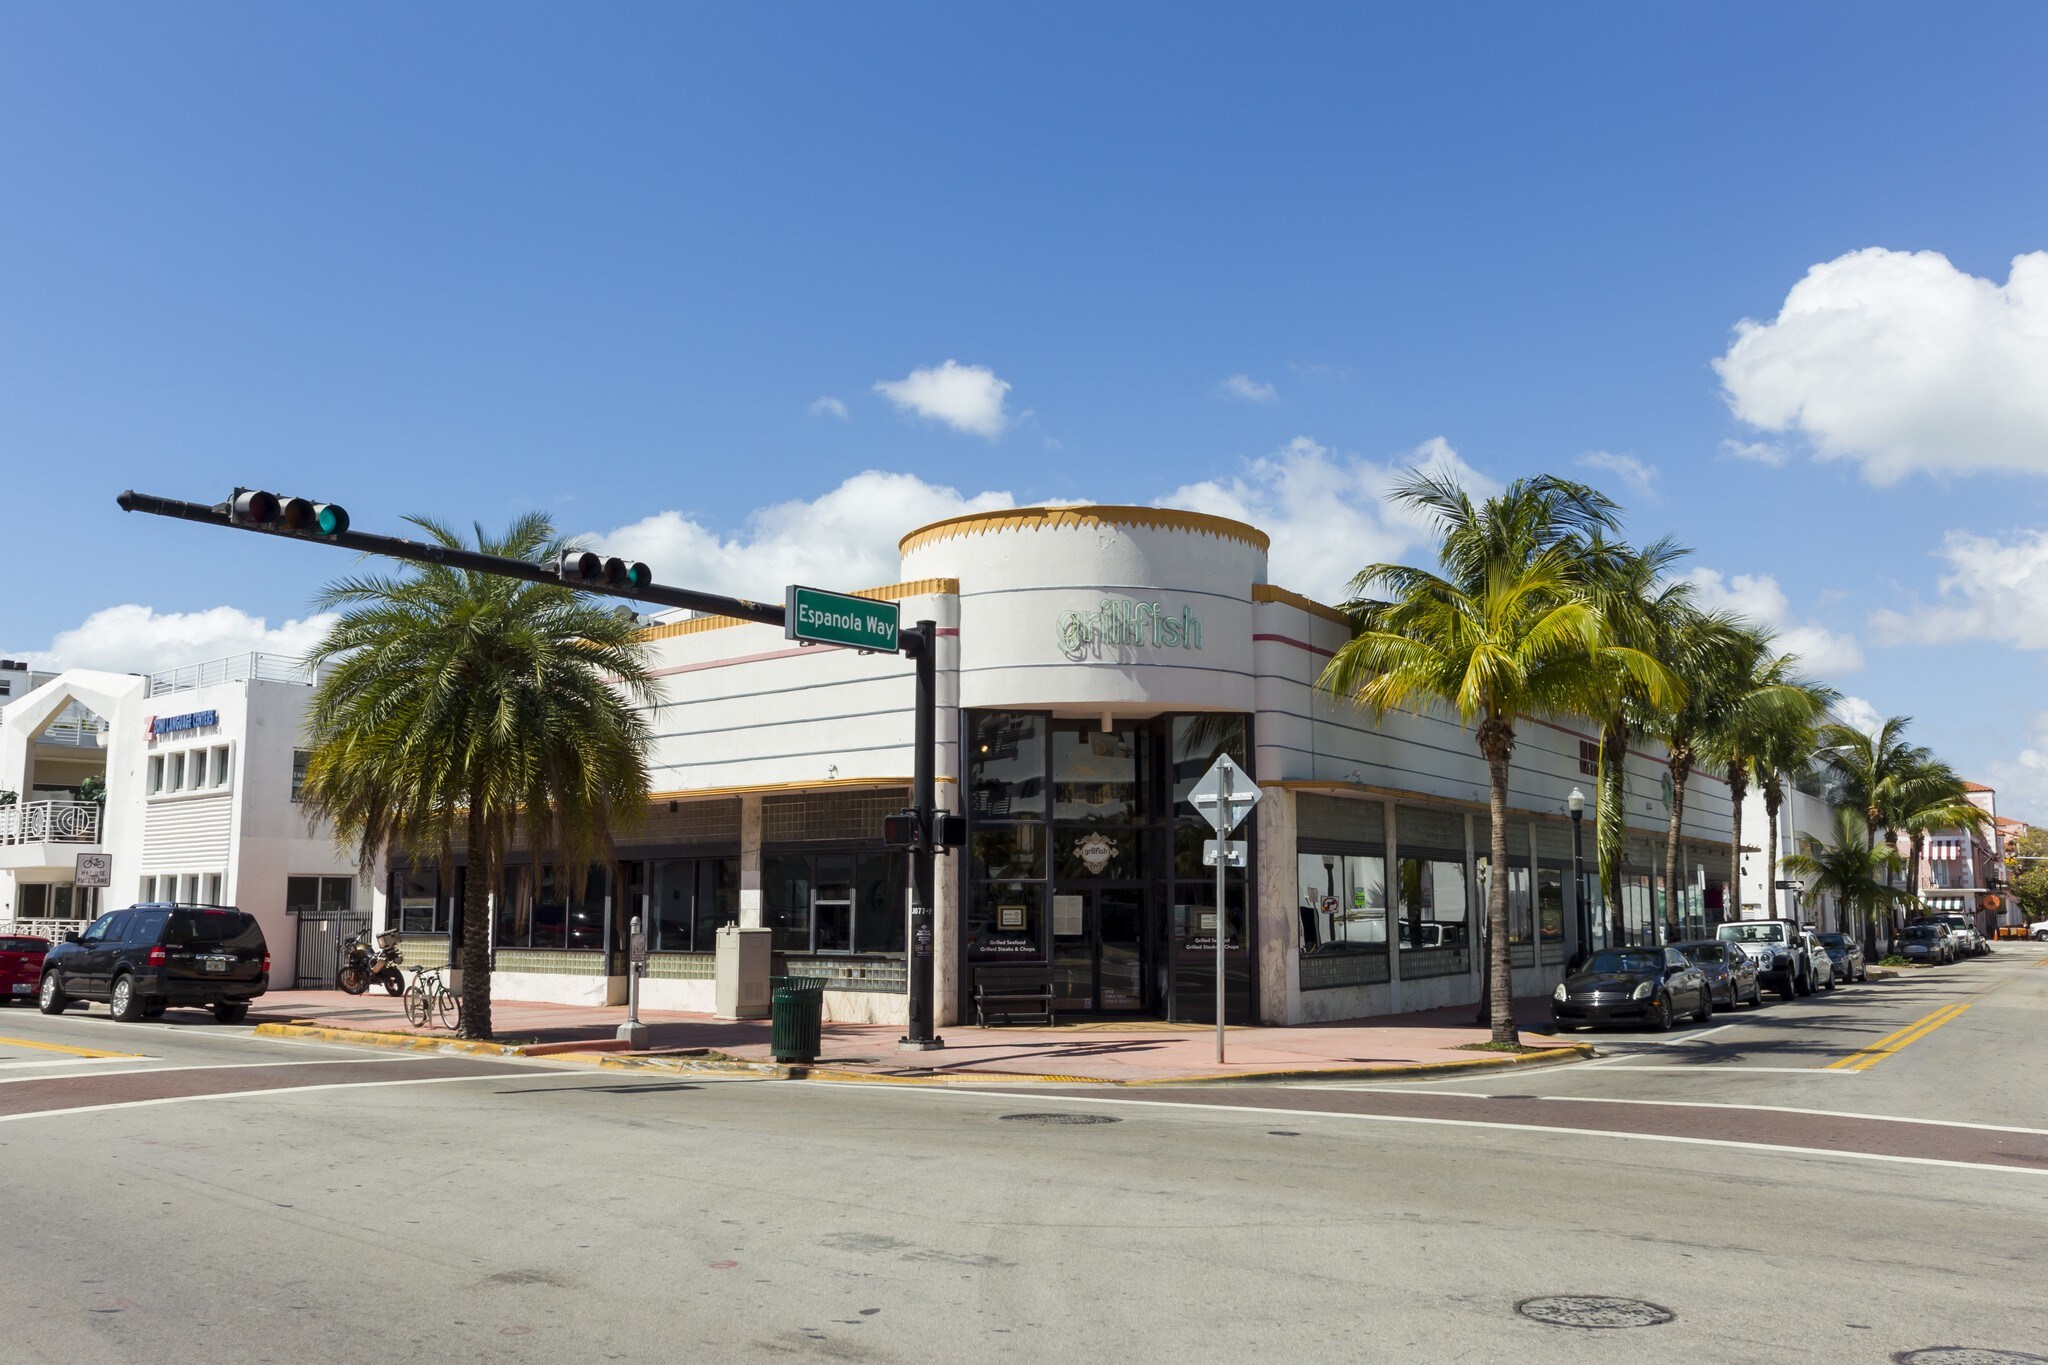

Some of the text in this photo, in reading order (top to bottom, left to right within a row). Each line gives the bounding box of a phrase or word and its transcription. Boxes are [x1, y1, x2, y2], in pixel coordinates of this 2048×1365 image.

[799, 603, 895, 640] Espanola Way
[1056, 599, 1203, 652] grillfish
[1084, 846, 1108, 857] grillfish
